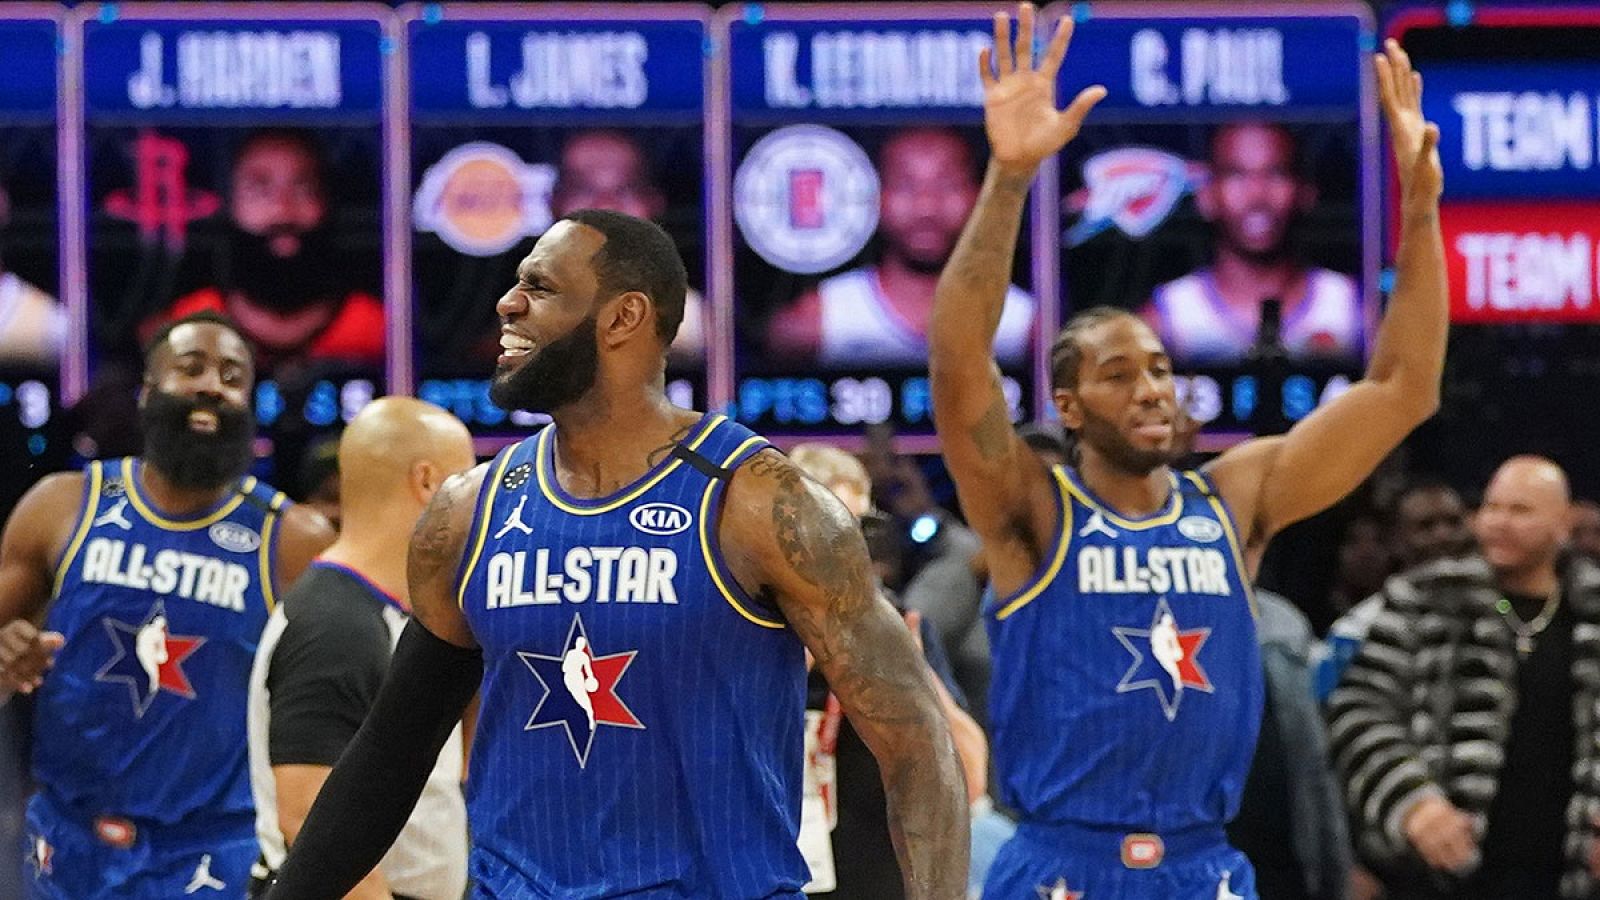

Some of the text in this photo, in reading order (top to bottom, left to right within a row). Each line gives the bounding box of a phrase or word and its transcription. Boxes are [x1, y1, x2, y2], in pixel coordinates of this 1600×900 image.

[1454, 91, 1592, 171] TEAM
[1456, 232, 1592, 310] TEAM
[739, 378, 828, 424] PTS
[639, 508, 682, 530] KIA
[82, 537, 250, 613] ALL-STAR
[486, 546, 679, 610] ALL-STAR
[1078, 546, 1231, 596] ALL-STAR
